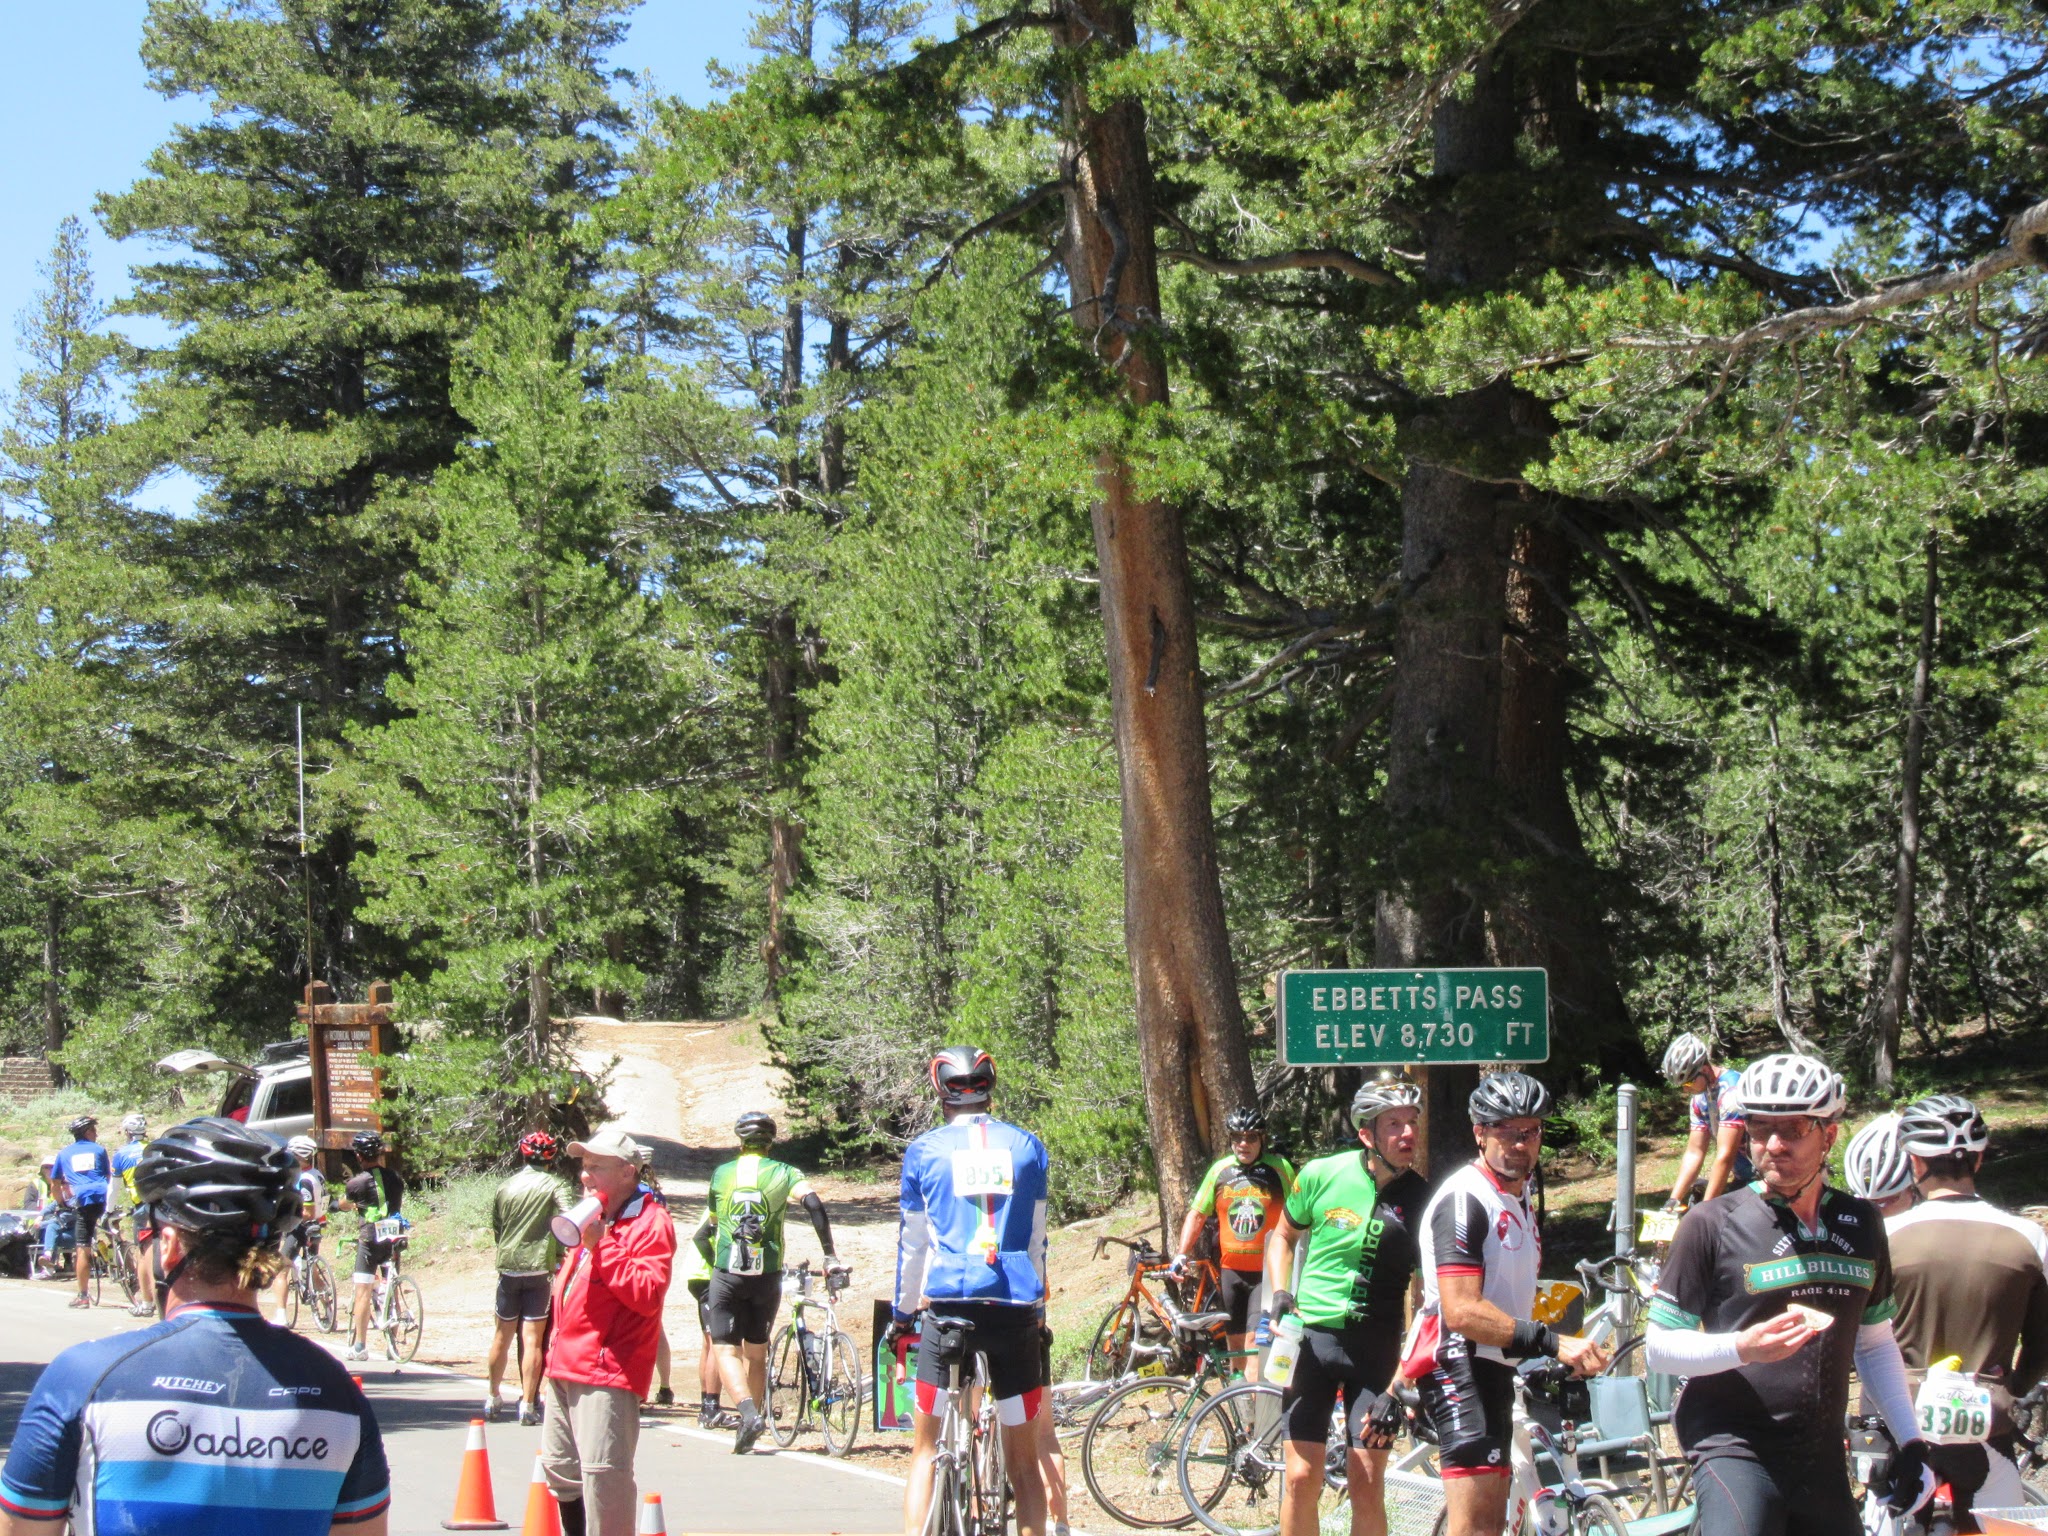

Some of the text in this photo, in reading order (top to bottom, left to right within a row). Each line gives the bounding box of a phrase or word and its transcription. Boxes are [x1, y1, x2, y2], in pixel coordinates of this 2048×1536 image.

[1312, 985, 1523, 1012] EBBETTS PASS
[1316, 1022, 1535, 1050] ELEV 8,730 FT
[1772, 1233, 1796, 1257] SIXTY
[1831, 1232, 1855, 1255] EIGHT
[1761, 1260, 1870, 1283] HILLBILLIES
[1827, 1286, 1850, 1296] 4:12
[152, 1376, 322, 1397] RITCHEY CAPO
[1921, 1405, 1985, 1436] 3308
[146, 1410, 329, 1460] Cadence
